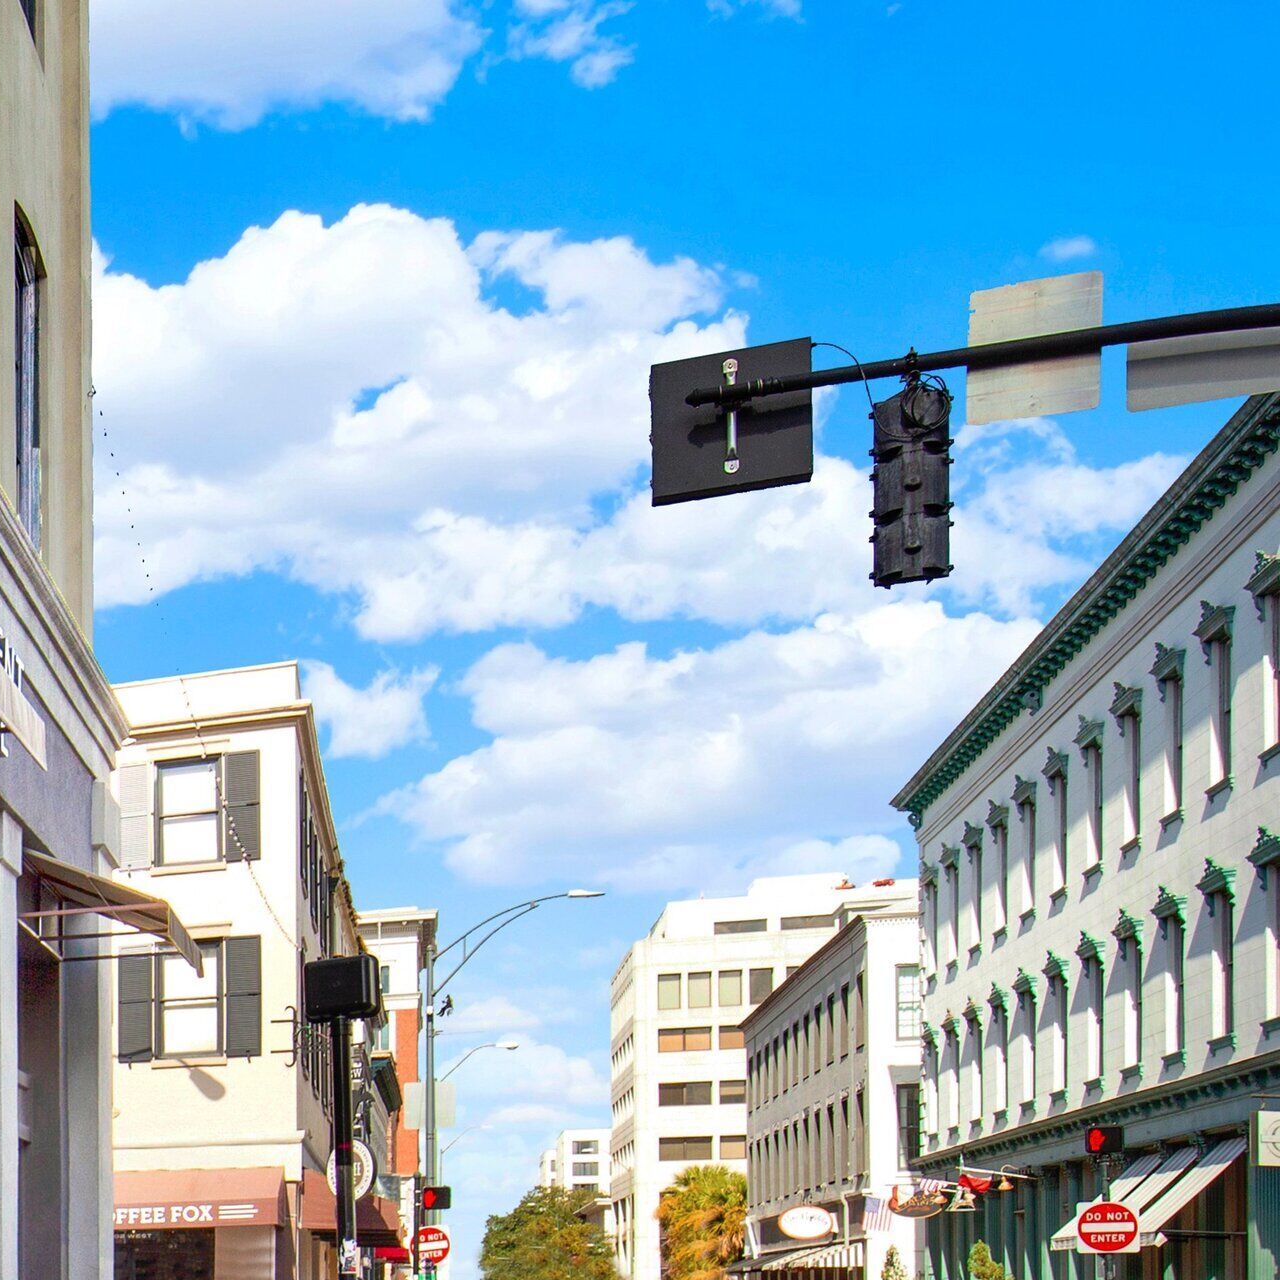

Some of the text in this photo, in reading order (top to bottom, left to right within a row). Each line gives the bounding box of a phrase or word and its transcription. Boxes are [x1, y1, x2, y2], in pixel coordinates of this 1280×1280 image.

[113, 1204, 214, 1225] FFEE FOX
[1086, 1211, 1130, 1221] DO NOT
[427, 1232, 443, 1242] NOT
[1090, 1233, 1126, 1243] ENTER
